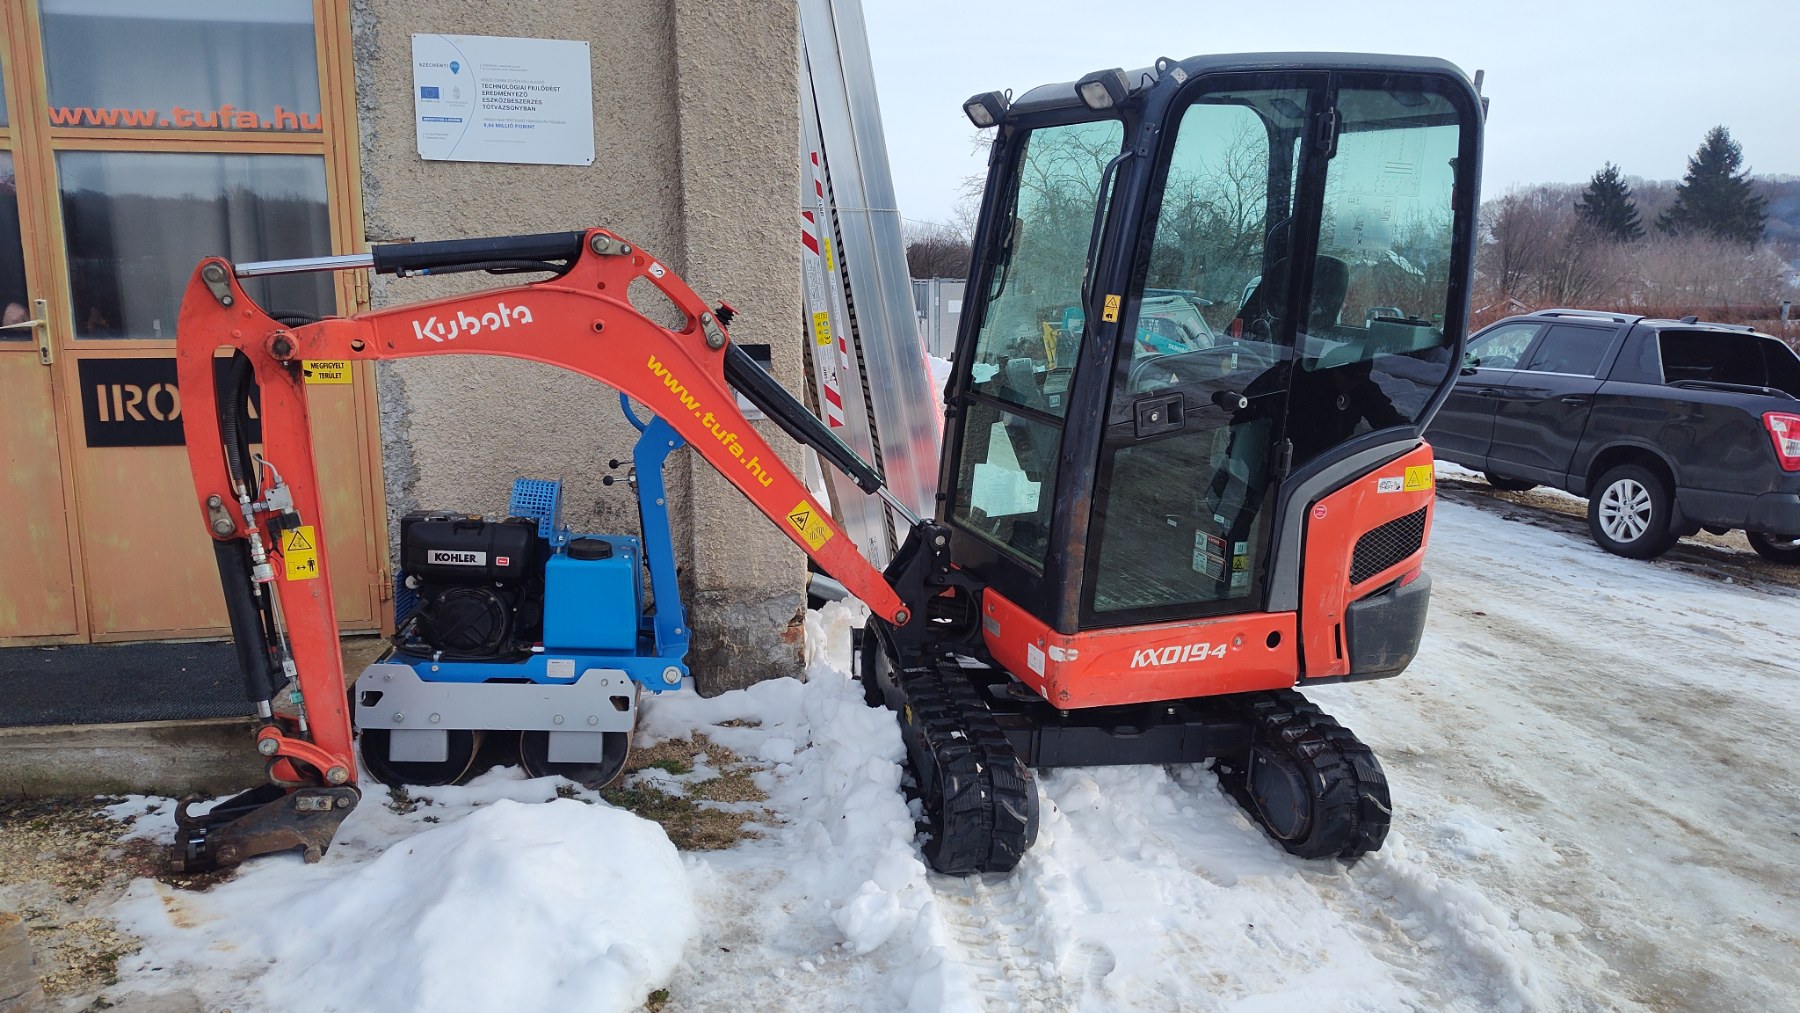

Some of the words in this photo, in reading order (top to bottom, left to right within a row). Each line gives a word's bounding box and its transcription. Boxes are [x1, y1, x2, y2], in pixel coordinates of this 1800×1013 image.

[48, 104, 321, 129] www.tufa.hu
[412, 302, 533, 342] Kubota
[310, 362, 345, 370] MEGFIGYELT
[318, 370, 342, 379] TERÜLET
[647, 355, 773, 487] www.tufa.hu
[434, 552, 476, 563] KOHLER
